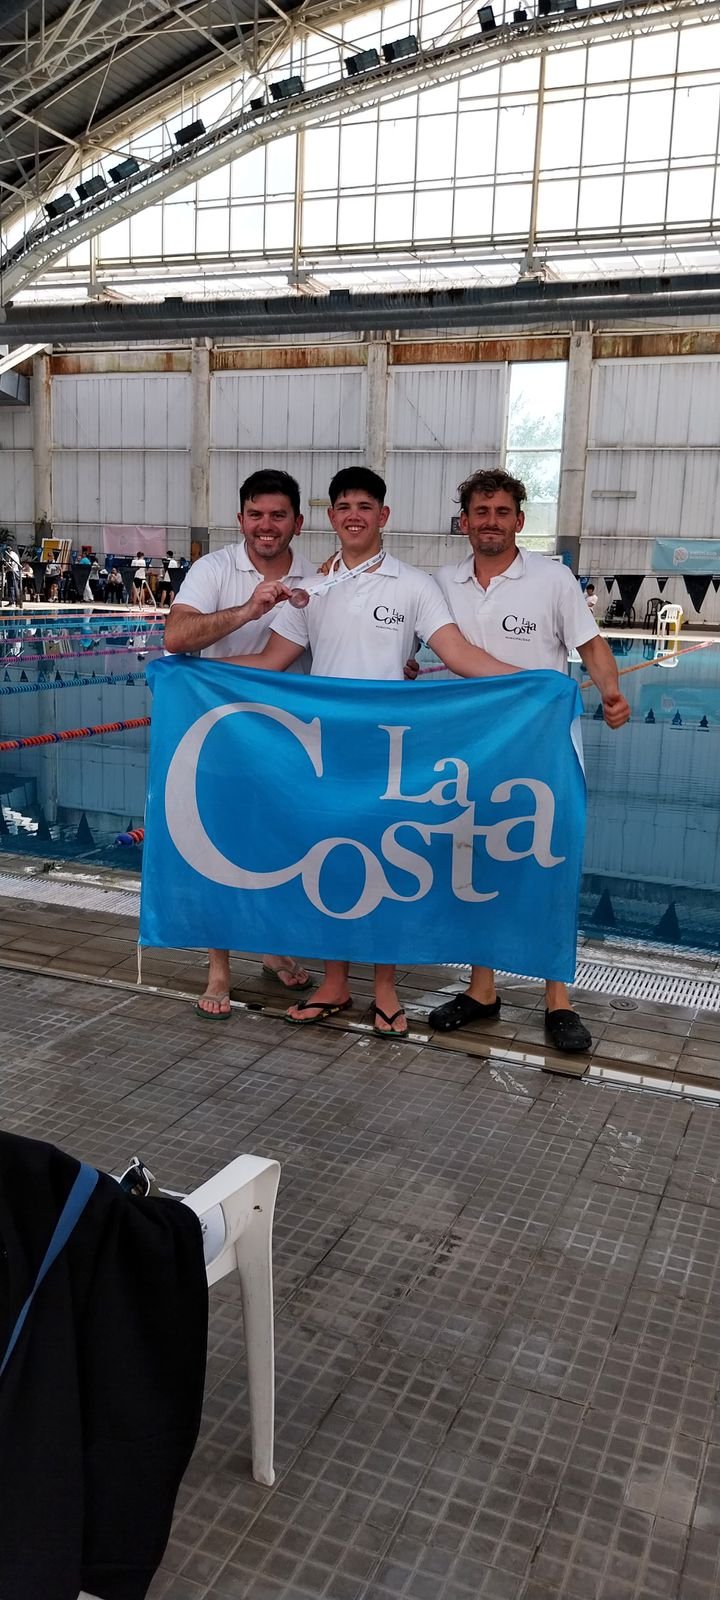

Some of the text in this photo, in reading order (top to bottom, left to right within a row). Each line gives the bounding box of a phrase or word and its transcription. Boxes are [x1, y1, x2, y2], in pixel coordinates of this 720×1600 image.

[373, 605, 405, 625] Costa
[502, 614, 537, 635] Costa
[377, 725, 470, 806] La
[165, 702, 566, 920] Costa
